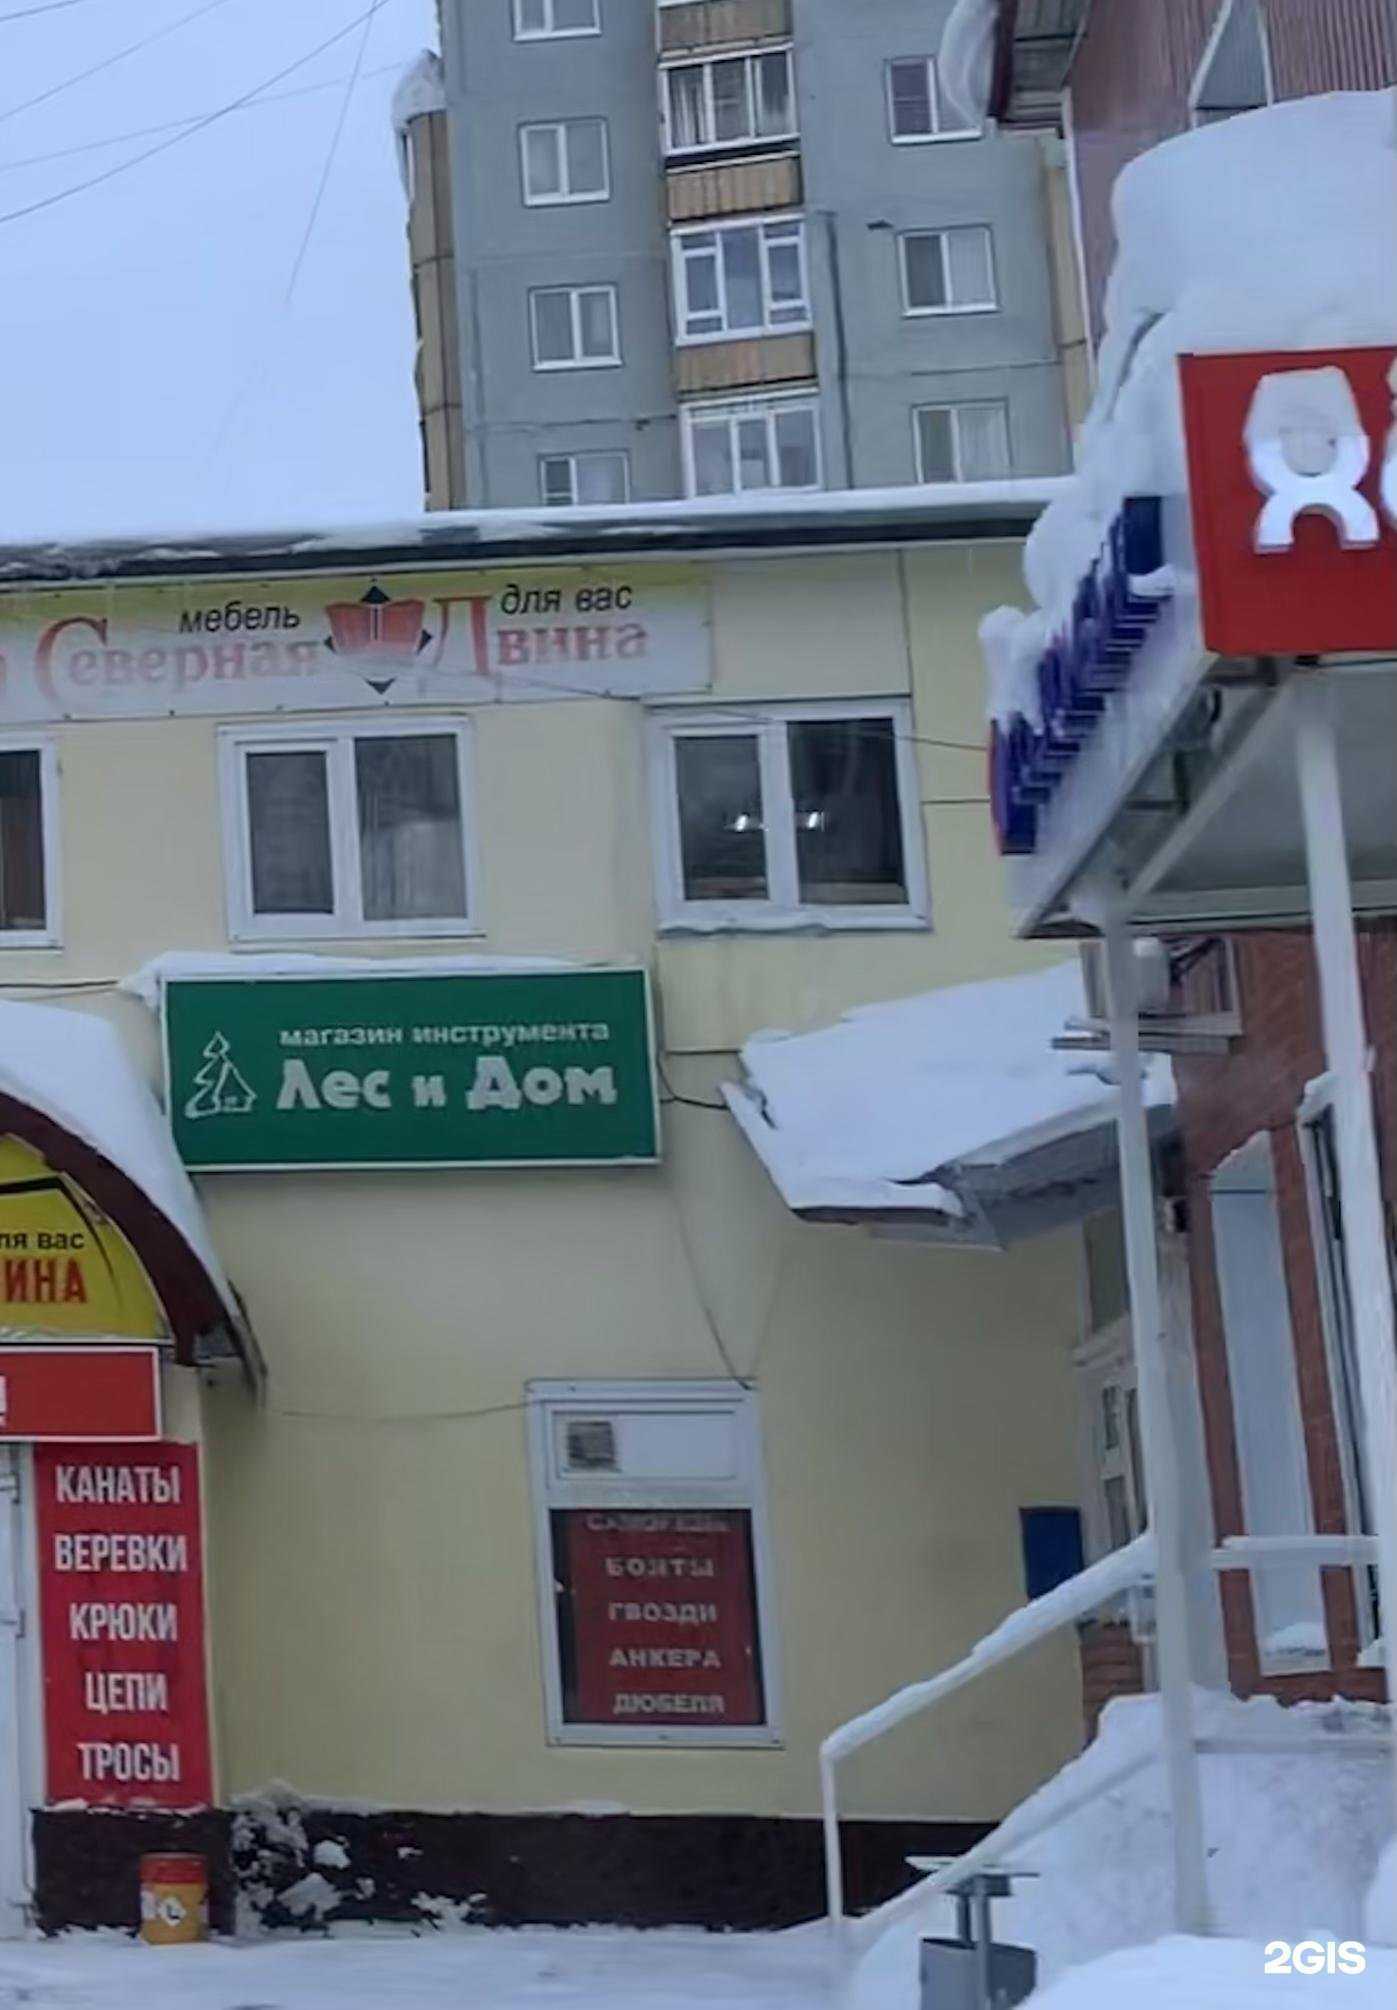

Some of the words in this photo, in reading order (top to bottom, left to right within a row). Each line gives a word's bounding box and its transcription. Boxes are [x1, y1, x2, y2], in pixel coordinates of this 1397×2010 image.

[179, 601, 301, 634] мебель
[500, 585, 562, 614] для
[575, 582, 634, 612] вас
[36, 616, 319, 704] Северная
[280, 1026, 402, 1046] магазин
[413, 1021, 609, 1047] инструмента
[275, 1059, 392, 1110] Лес
[412, 1073, 447, 1107] и
[465, 1056, 618, 1110] Дом
[37, 1232, 85, 1250] вас
[5, 1257, 88, 1304] ИНА
[55, 1466, 181, 1503] КАНАТЫ
[54, 1534, 188, 1572] ВЕРЕВКИ
[605, 1557, 715, 1577] БОЛТЫ
[69, 1602, 178, 1641] КРЮКИ
[608, 1602, 718, 1625] ГВОЗДИ
[609, 1649, 722, 1668] АНКЕРА
[84, 1672, 168, 1714] ЦЕПИ
[612, 1694, 725, 1714] ДЮБЕЛЯ
[76, 1742, 181, 1782] ТРОСЫ
